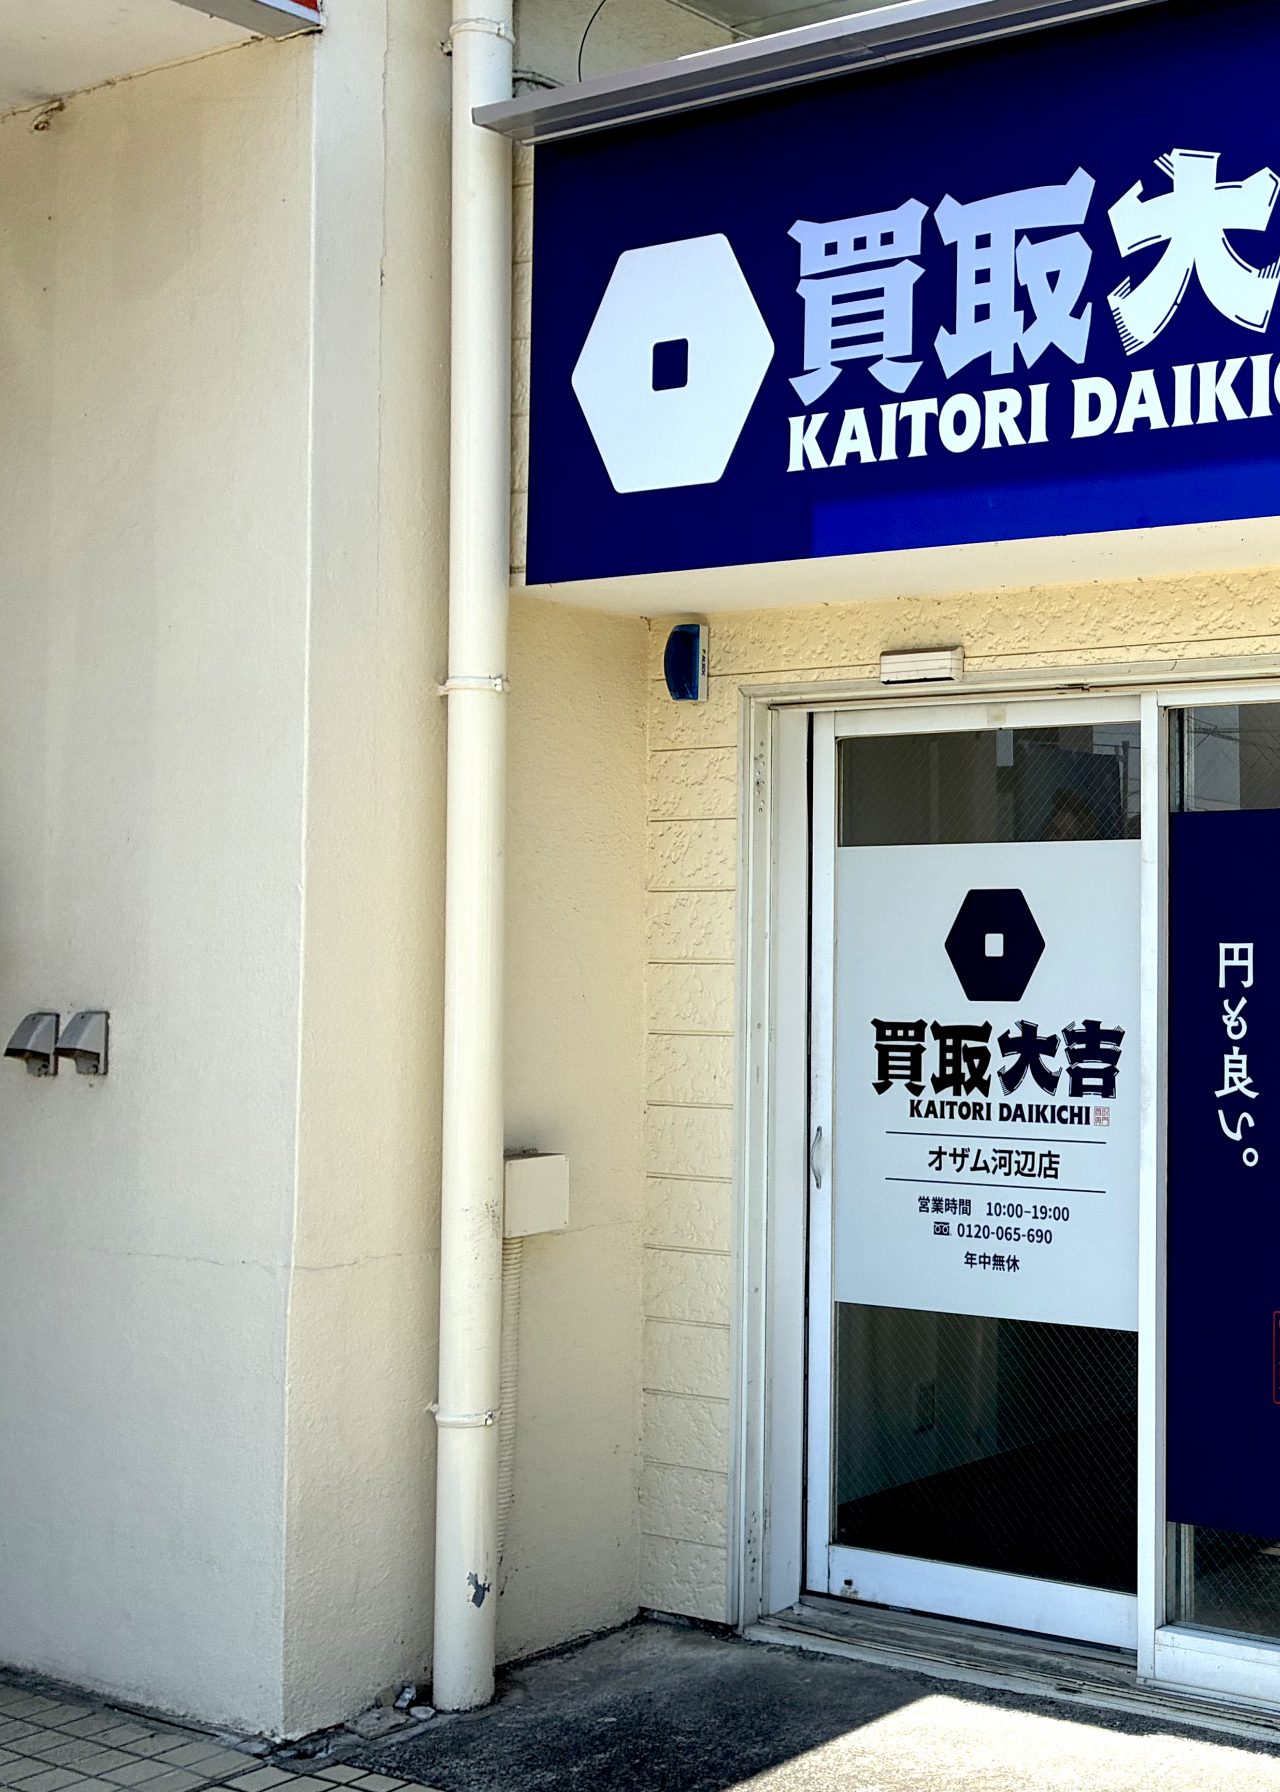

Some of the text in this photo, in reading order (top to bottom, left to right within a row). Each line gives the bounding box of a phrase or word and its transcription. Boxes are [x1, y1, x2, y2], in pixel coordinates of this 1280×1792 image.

[787, 383, 1049, 472] KAITORI
[871, 1019, 1125, 1098] 買取大吉
[1214, 943, 1259, 1167] 円も良い。
[909, 1099, 1091, 1125] KAITORI DAIKICHI
[928, 1145, 1060, 1180] オザム河辺店
[918, 1196, 972, 1216] 営業時間
[957, 1223, 1053, 1244] 0120-065-690
[964, 1251, 1020, 1273] 年中無休
